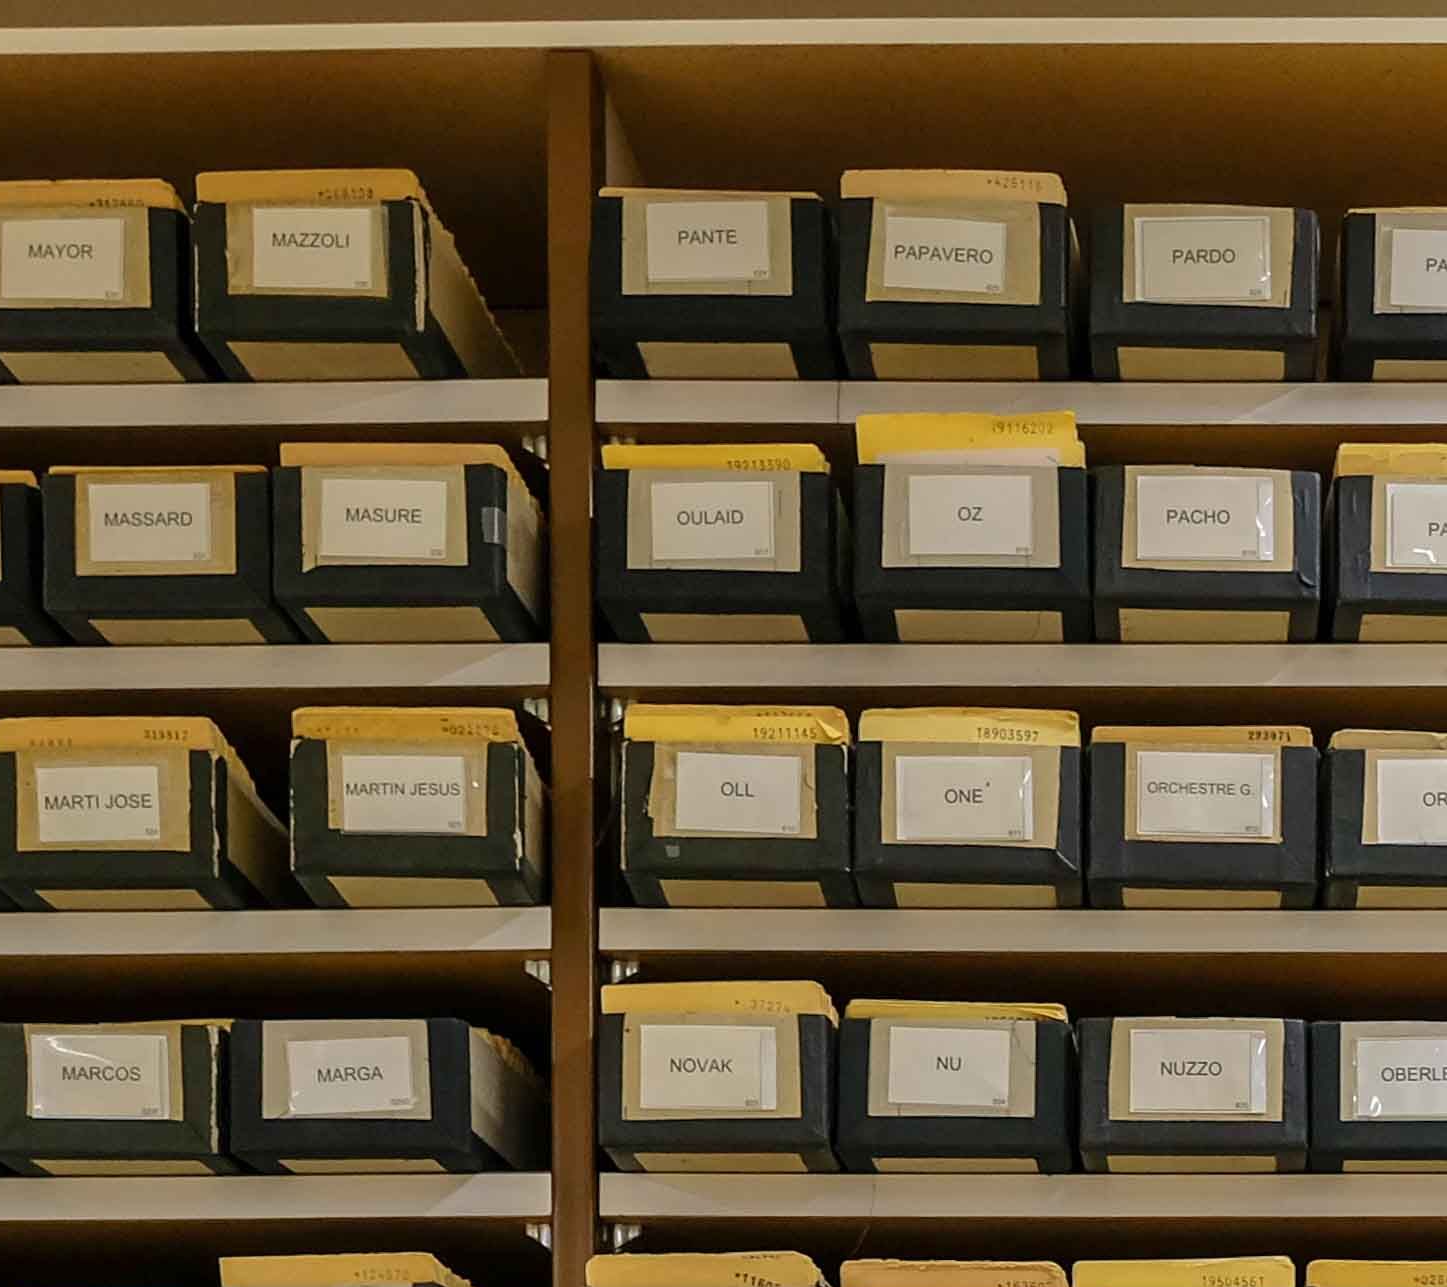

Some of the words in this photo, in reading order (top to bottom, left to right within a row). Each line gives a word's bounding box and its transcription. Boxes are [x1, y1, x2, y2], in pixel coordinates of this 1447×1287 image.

[271, 232, 350, 249] MAZZOLI
[677, 228, 737, 245] PANTE
[1172, 248, 1236, 265] PARDO
[103, 511, 193, 528] MASSARD
[345, 507, 422, 524] MASURE
[957, 506, 984, 522] OZ
[1166, 509, 1231, 525] PACHO
[752, 725, 818, 740] 19211145
[720, 781, 755, 798] OLL
[943, 788, 984, 805] ONE
[936, 1055, 962, 1072] NU
[1160, 1060, 1223, 1077] NUZZO
[62, 1065, 142, 1082] MARCOS
[317, 1065, 384, 1084] MARGA
